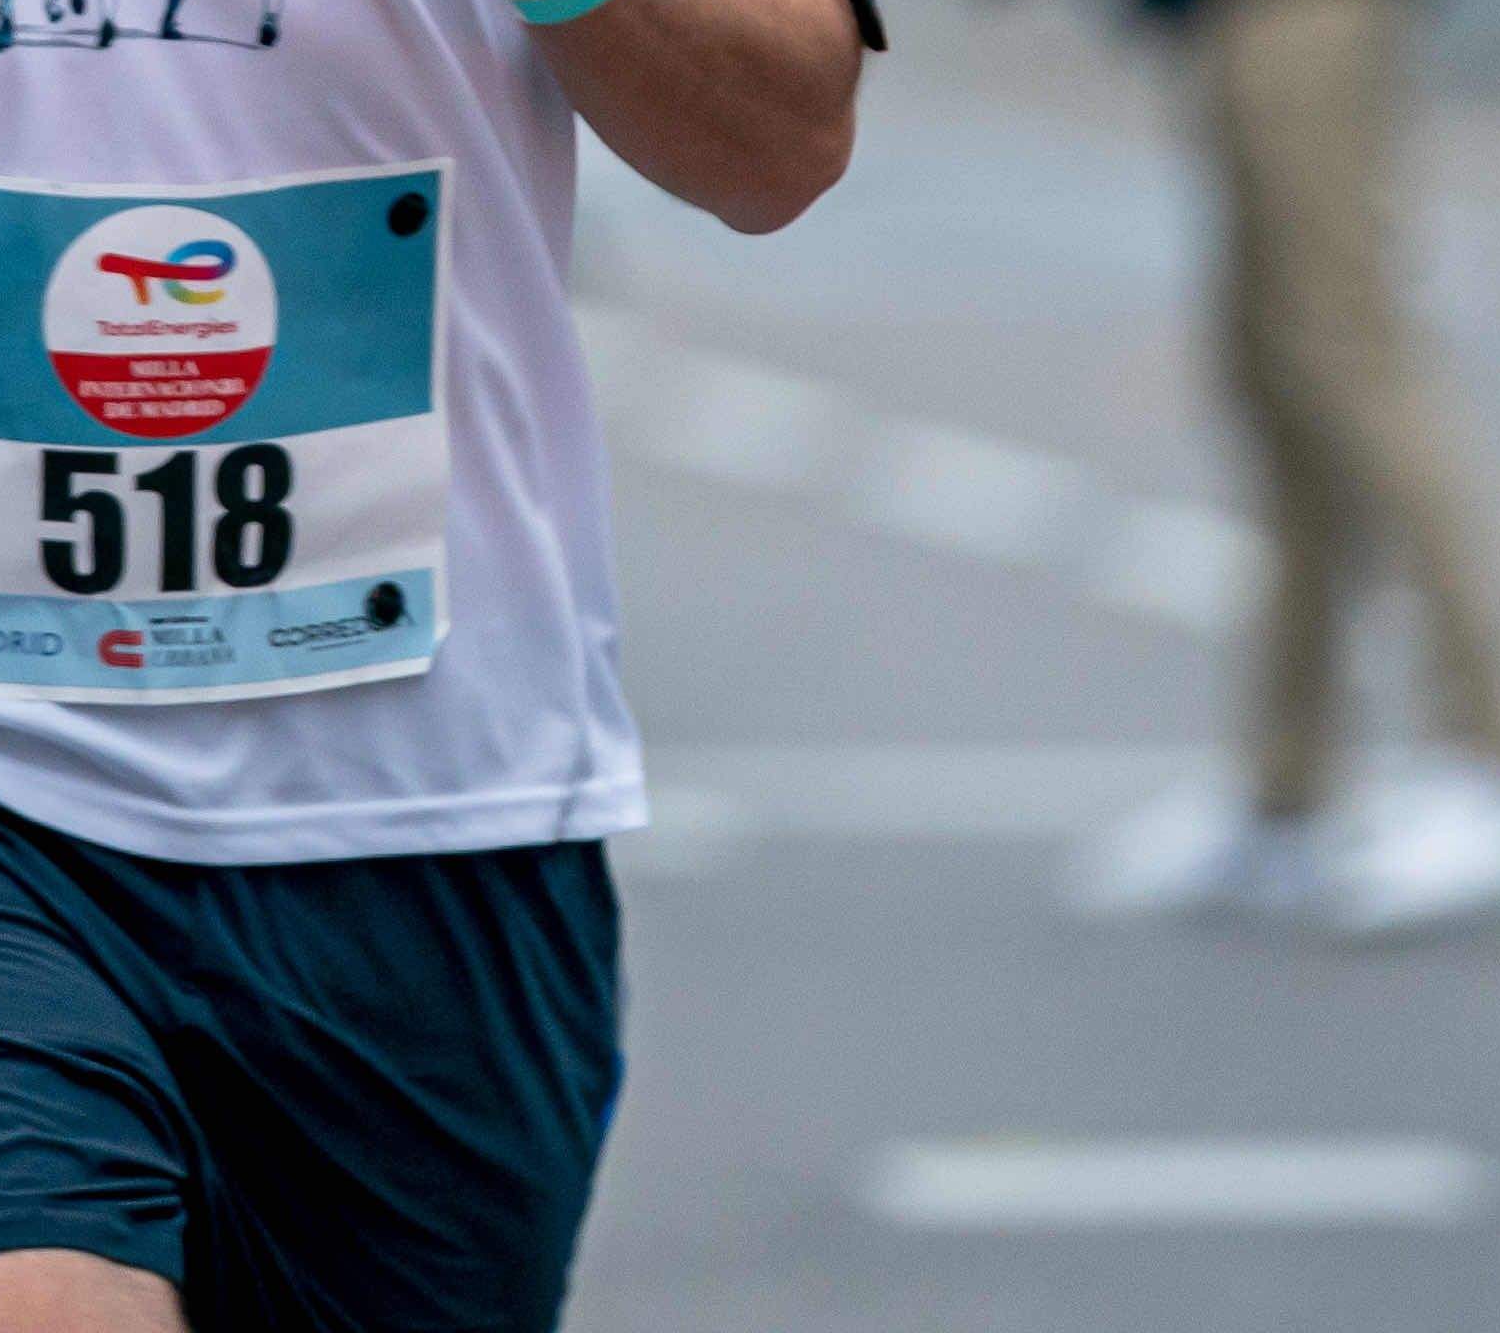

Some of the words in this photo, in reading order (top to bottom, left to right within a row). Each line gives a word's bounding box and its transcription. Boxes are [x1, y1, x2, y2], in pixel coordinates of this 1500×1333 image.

[96, 319, 239, 339] TotalEnergies
[129, 360, 201, 378] MILLA
[77, 377, 247, 399] INTERNACIONAL
[103, 401, 136, 420] DE
[140, 398, 227, 418] MADRID
[38, 442, 294, 595] 518
